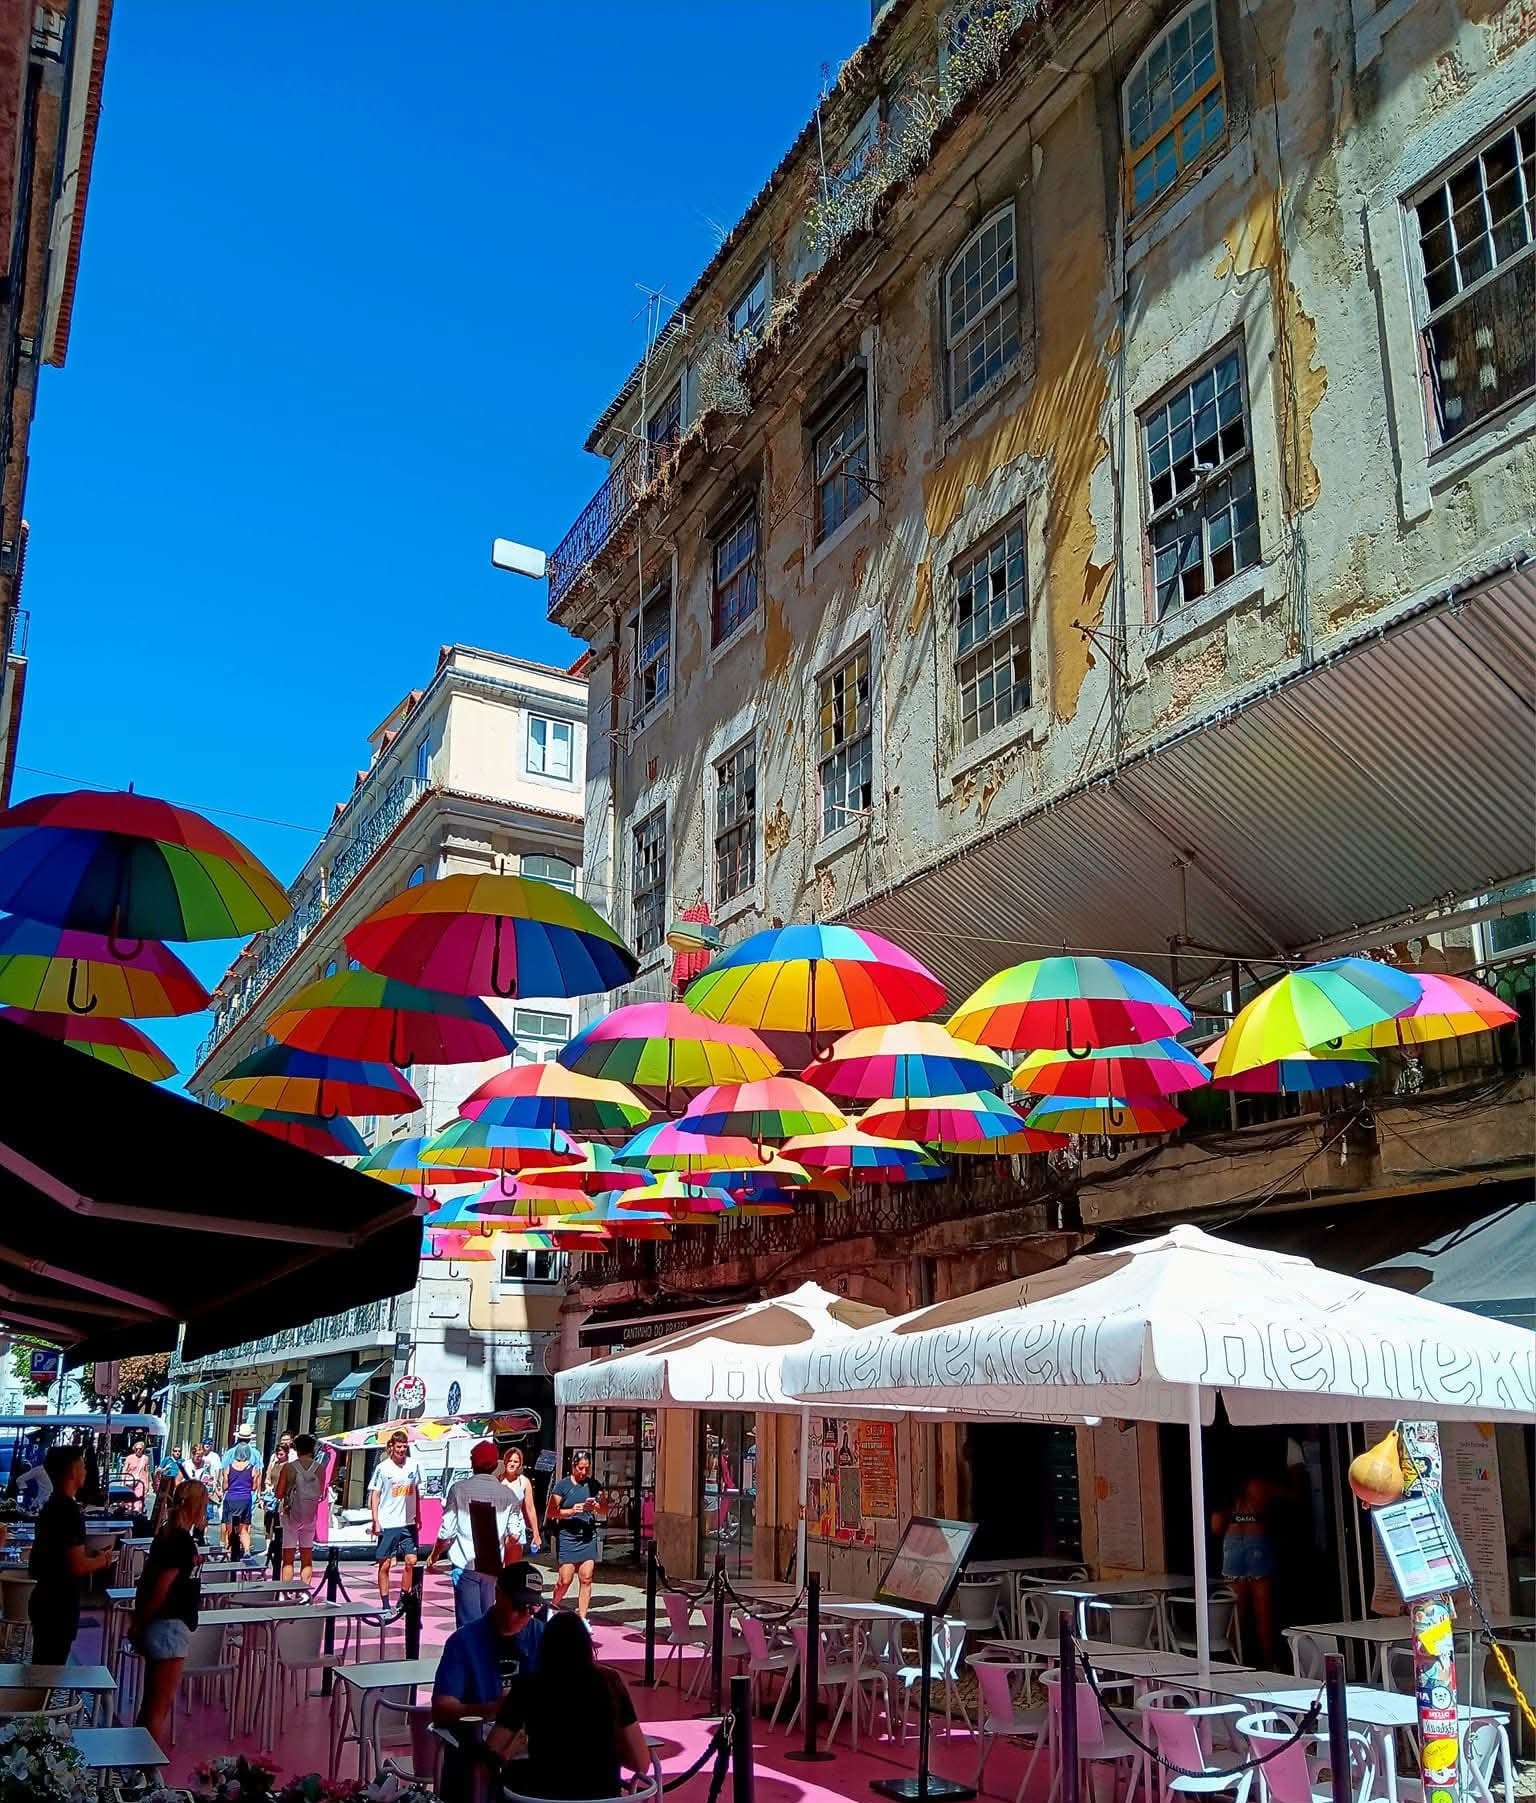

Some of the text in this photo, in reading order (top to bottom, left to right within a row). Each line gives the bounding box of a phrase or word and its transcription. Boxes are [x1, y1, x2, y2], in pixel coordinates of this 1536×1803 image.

[624, 1325, 652, 1340] CANTINHO
[654, 1323, 664, 1337] DO
[34, 1353, 44, 1368] P
